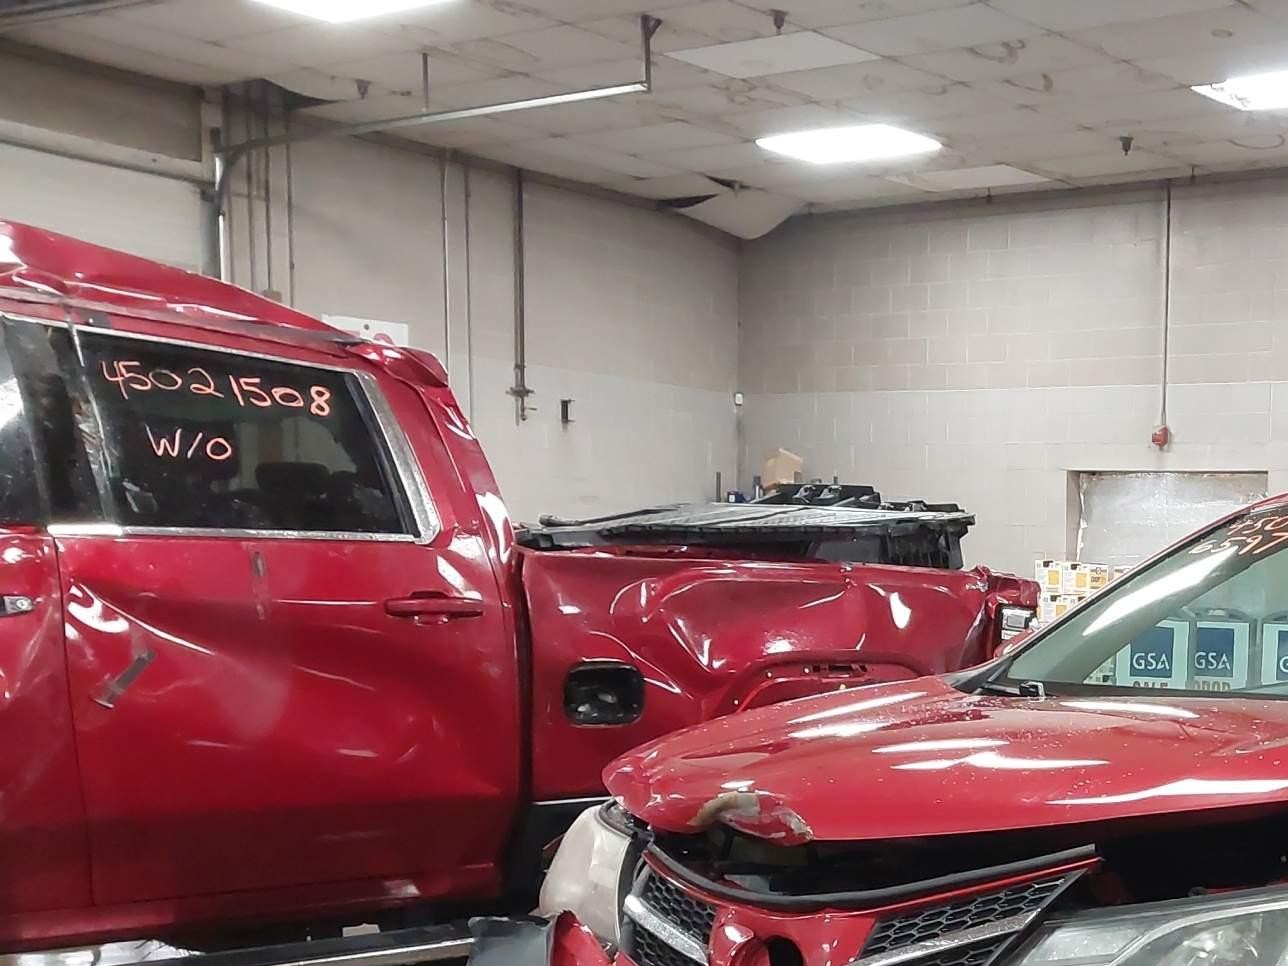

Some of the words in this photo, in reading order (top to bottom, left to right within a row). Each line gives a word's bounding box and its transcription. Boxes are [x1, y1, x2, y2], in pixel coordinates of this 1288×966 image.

[101, 360, 331, 417] 45021508
[145, 424, 232, 460] W/O
[1132, 652, 1170, 671] GSA
[1194, 651, 1231, 671] GSA
